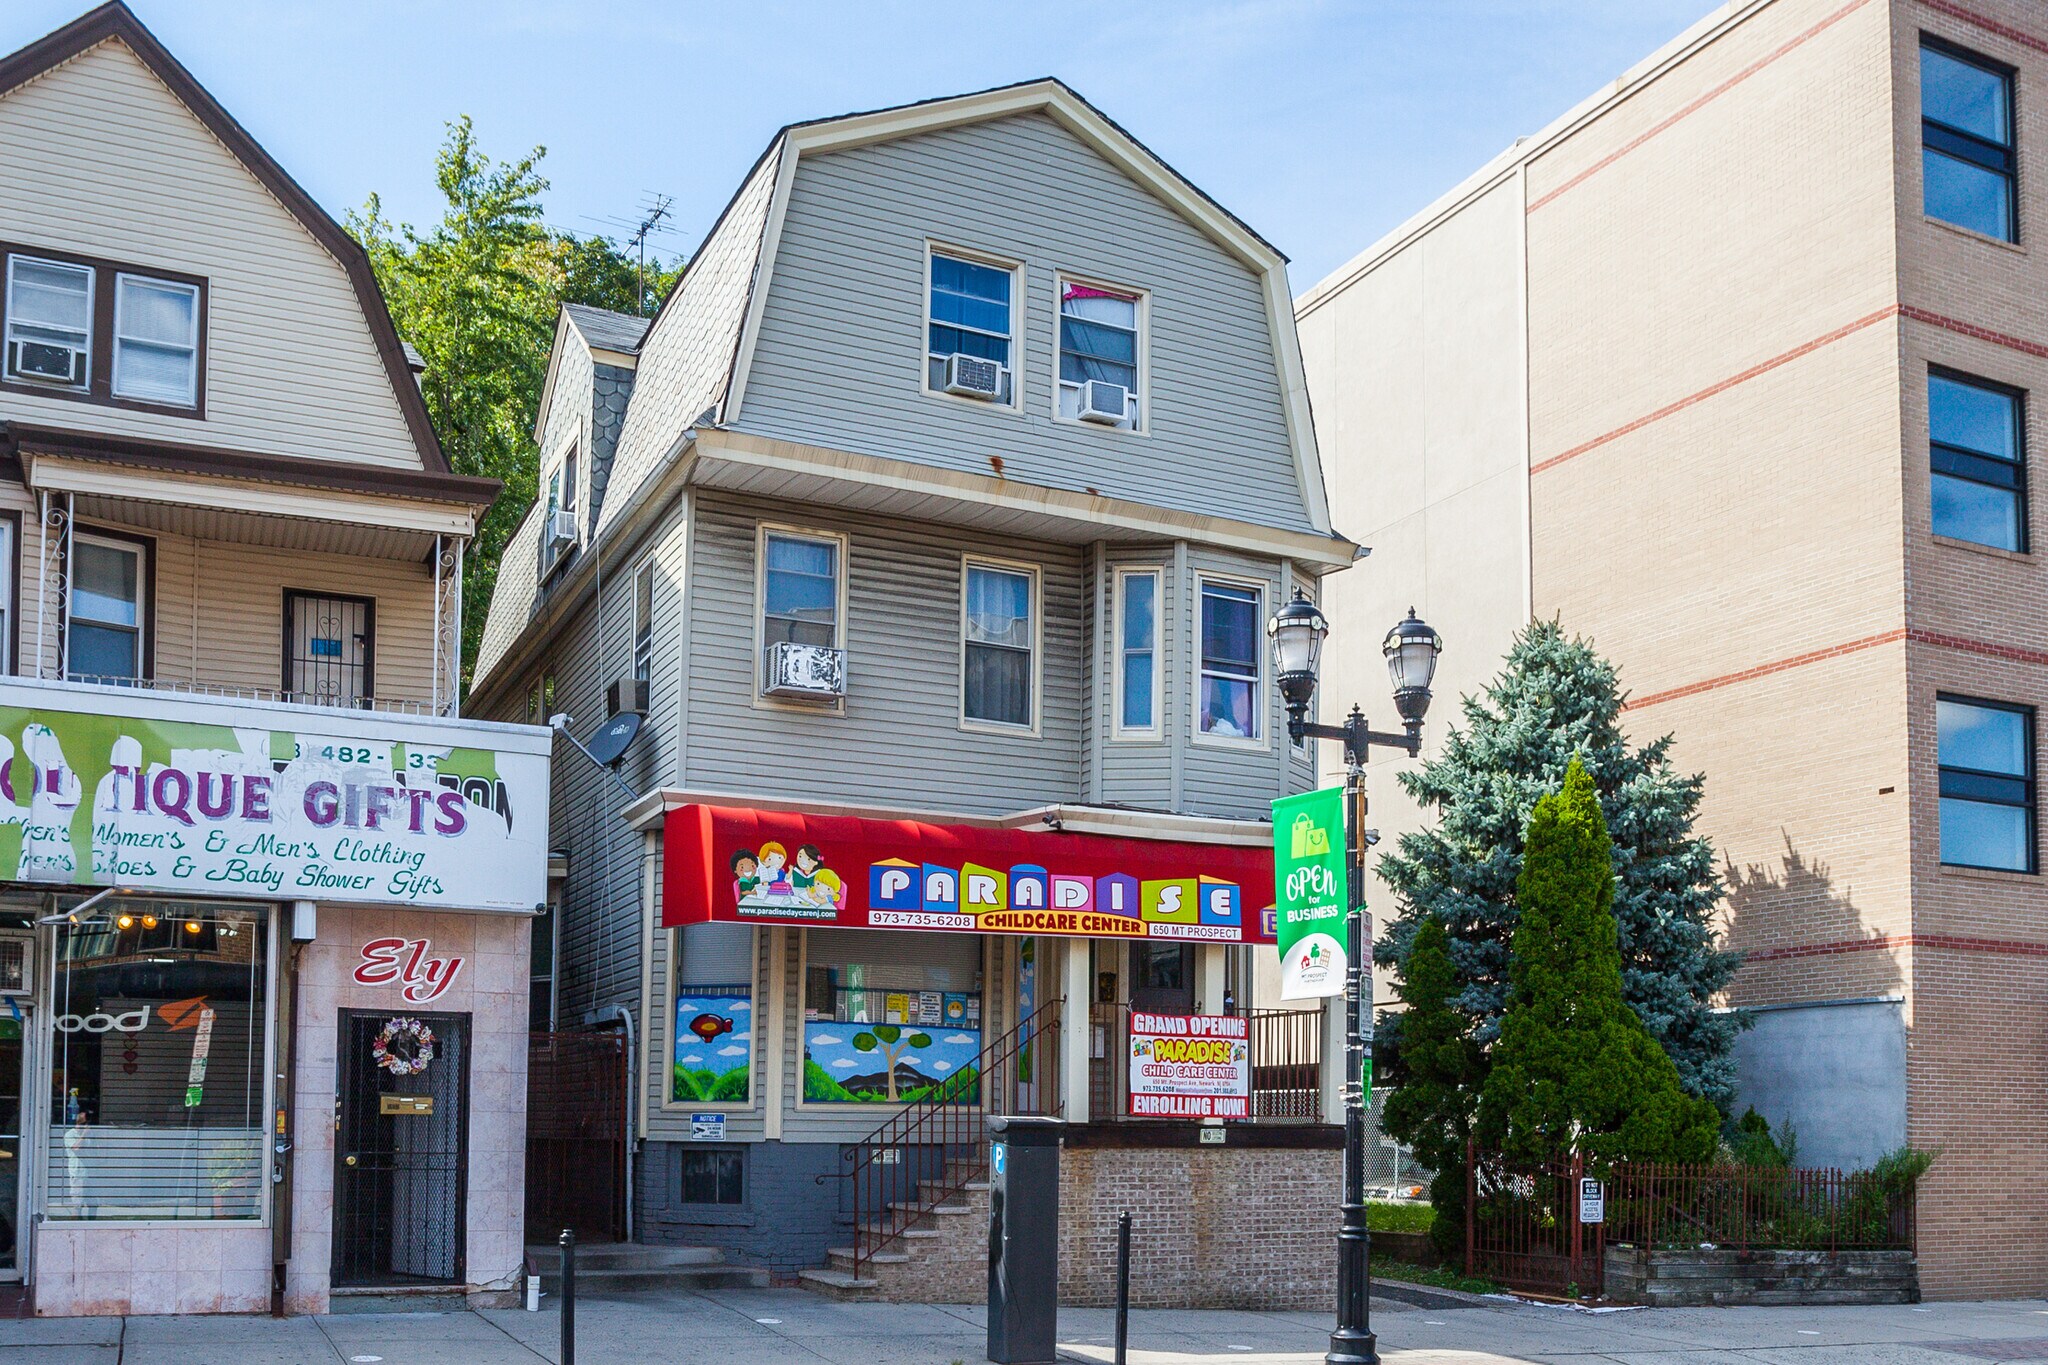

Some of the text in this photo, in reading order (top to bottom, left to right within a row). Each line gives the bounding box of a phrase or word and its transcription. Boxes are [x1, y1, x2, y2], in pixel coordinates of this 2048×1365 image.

[303, 780, 468, 837] GIFTS
[205, 829, 231, 852] &
[236, 832, 320, 859] Men's
[333, 838, 426, 871] Clothing
[172, 855, 197, 879] &
[205, 858, 284, 891] Baby
[296, 863, 375, 889] Shower
[388, 869, 444, 899] Gifts
[880, 869, 1232, 917] PARADISE
[1308, 895, 1321, 904] for
[738, 906, 837, 919] www.paradisedaycarenj.com
[873, 912, 971, 927] 973-735-6208
[984, 913, 1141, 933] CHILDCARE CENTER
[1287, 904, 1339, 923] BUSINESS
[1153, 924, 1238, 939] 650 MT PROSPECT
[353, 937, 466, 1004] Ely
[1133, 1013, 1246, 1037] GRAND OPENING
[1153, 1038, 1231, 1064] PARADISE
[1142, 1064, 1238, 1079] CHILD CARE CENTER
[1133, 1095, 1246, 1116] ENROLLING NOW!
